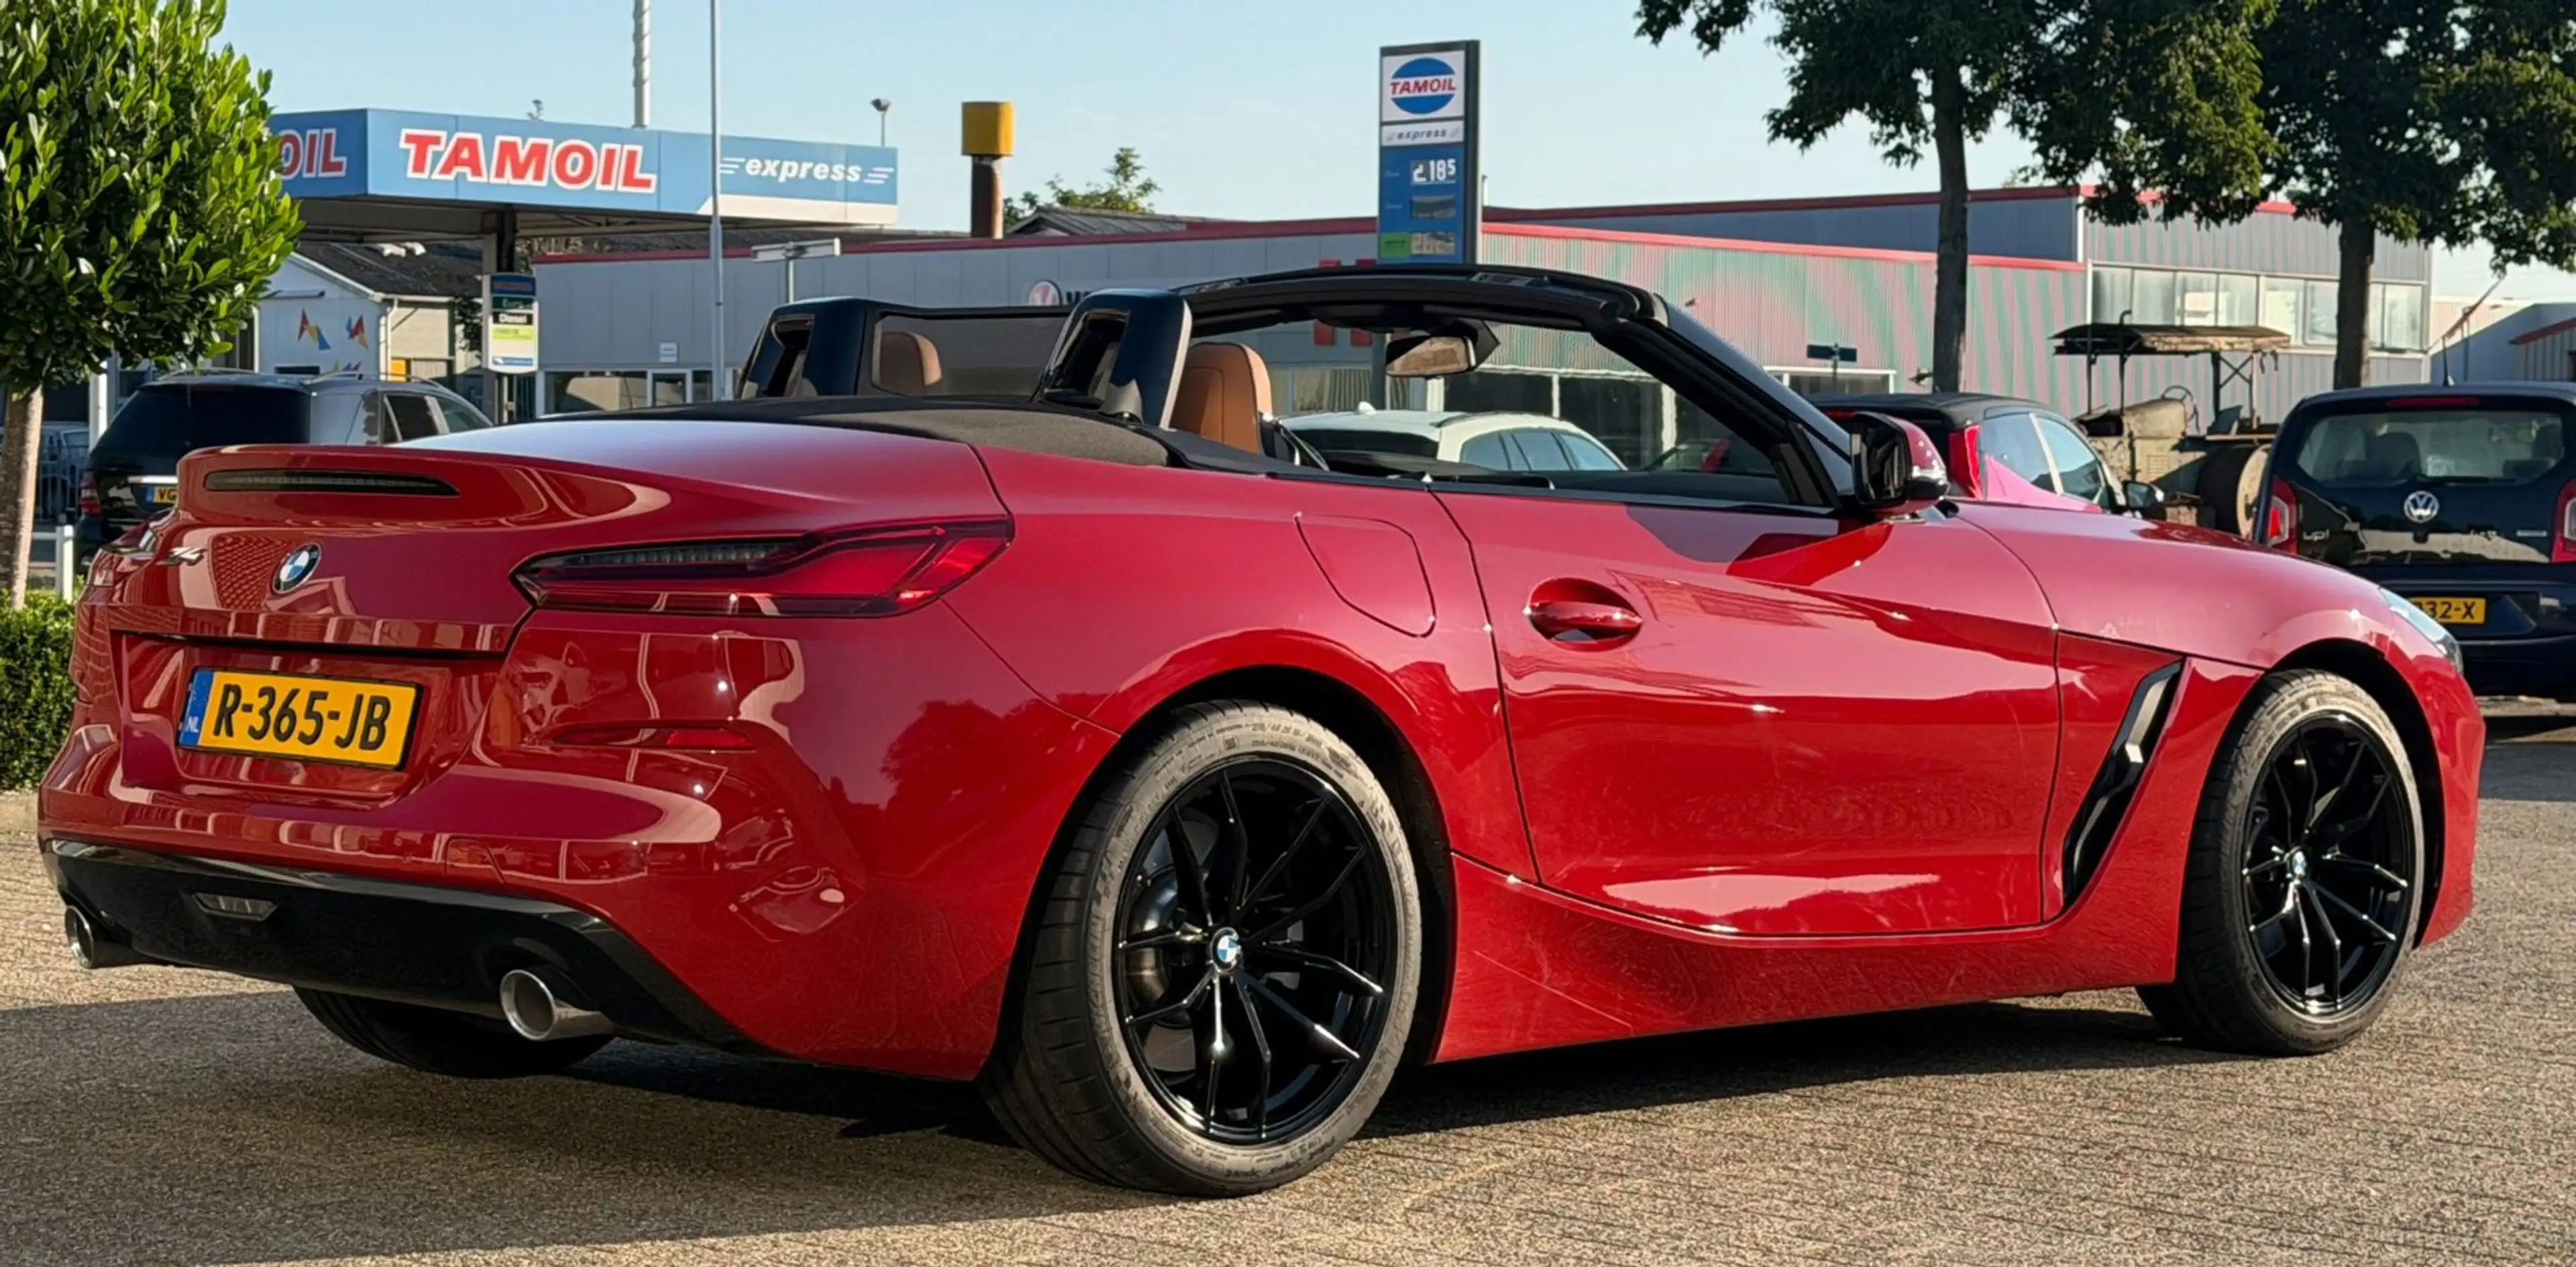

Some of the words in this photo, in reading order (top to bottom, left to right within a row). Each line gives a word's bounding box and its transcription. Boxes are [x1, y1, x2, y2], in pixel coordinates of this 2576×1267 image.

[1390, 78, 1457, 95] TAMOIL
[1397, 129, 1447, 140] express
[399, 128, 657, 193] TAMOIL
[745, 157, 863, 184] express
[2302, 528, 2330, 542] up!
[186, 716, 200, 733] NL
[213, 683, 391, 750] R-365-JB
